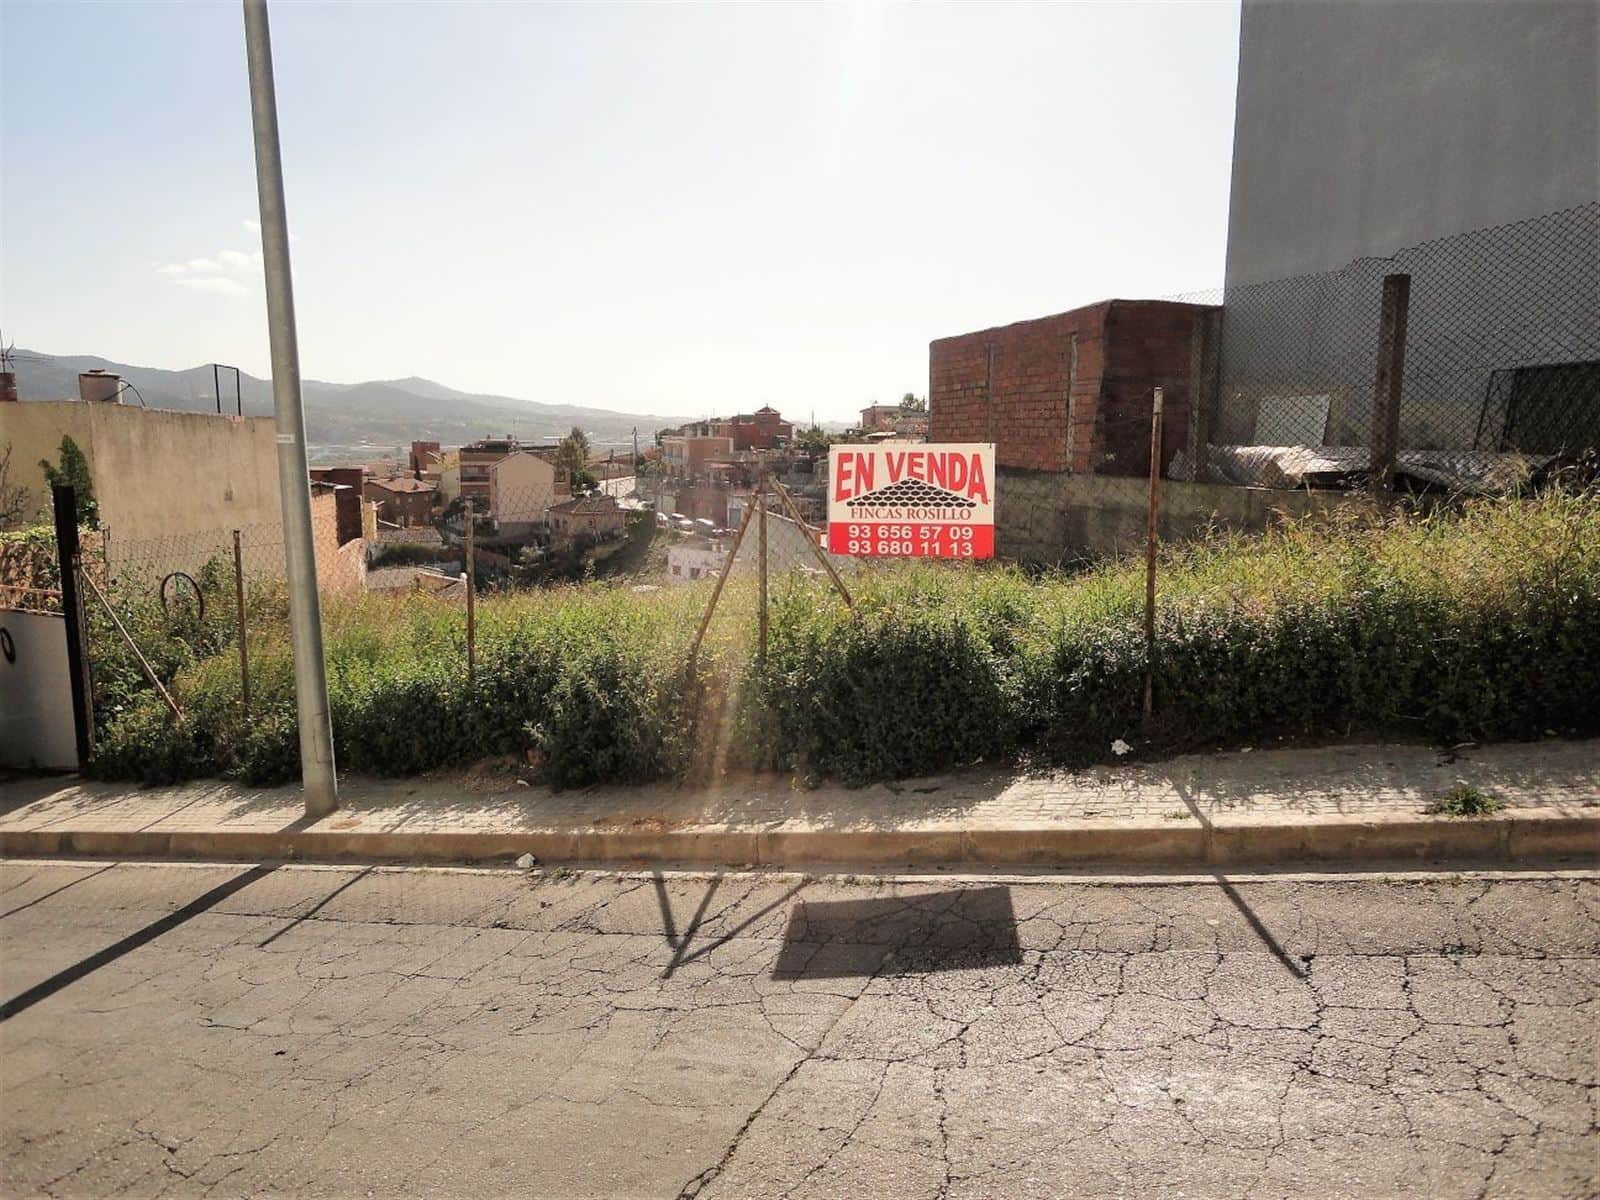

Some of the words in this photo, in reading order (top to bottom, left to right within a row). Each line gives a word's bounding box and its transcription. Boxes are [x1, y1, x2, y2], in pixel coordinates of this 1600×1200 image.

[836, 452, 875, 503] EN
[886, 452, 988, 505] VENDA
[851, 508, 902, 520] FINCAS
[906, 508, 972, 521] ROSILLO
[848, 525, 871, 538] 93
[877, 526, 913, 539] 656
[919, 526, 943, 539] 57
[949, 526, 973, 540] 09
[848, 541, 871, 554] 93
[877, 541, 913, 555] 680
[921, 542, 940, 555] 11
[950, 542, 973, 556] 13
